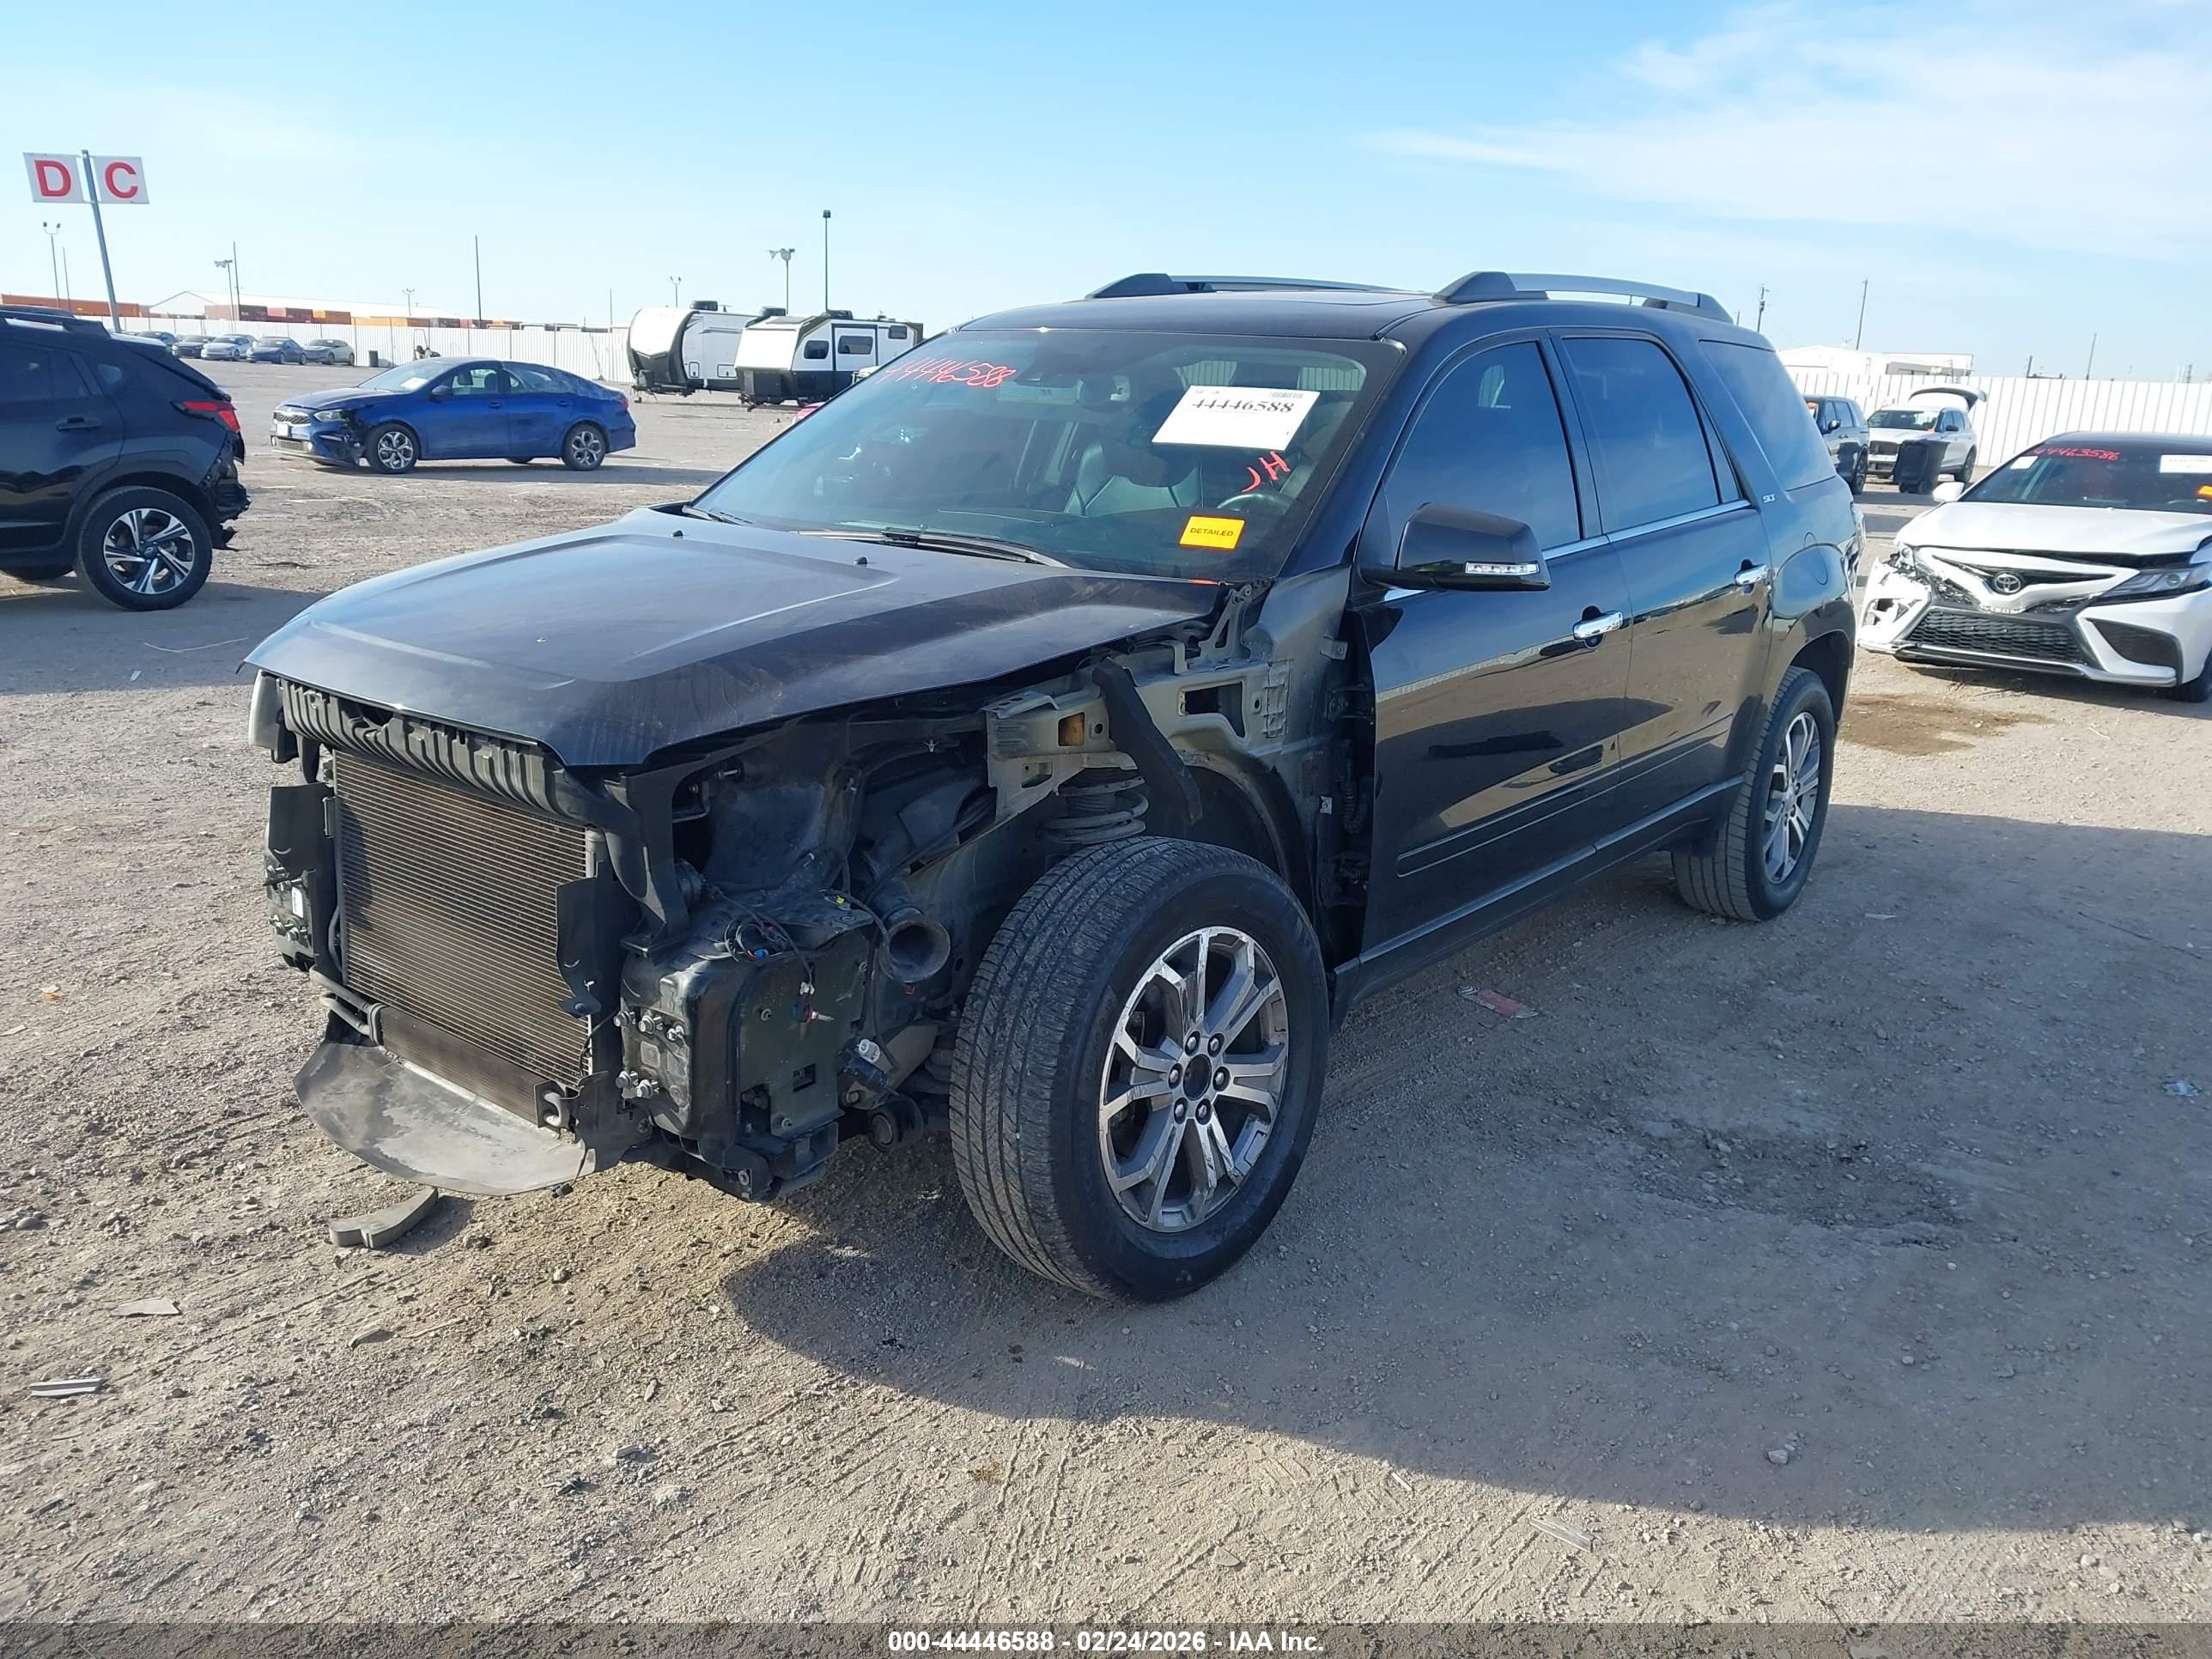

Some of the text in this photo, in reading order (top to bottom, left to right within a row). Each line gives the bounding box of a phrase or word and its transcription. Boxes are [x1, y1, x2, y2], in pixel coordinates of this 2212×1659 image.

[34, 160, 71, 197] D
[105, 161, 138, 198] C
[875, 357, 1017, 387] 44446588
[1192, 398, 1295, 413] 44446588
[1189, 527, 1234, 537] DETAILED
